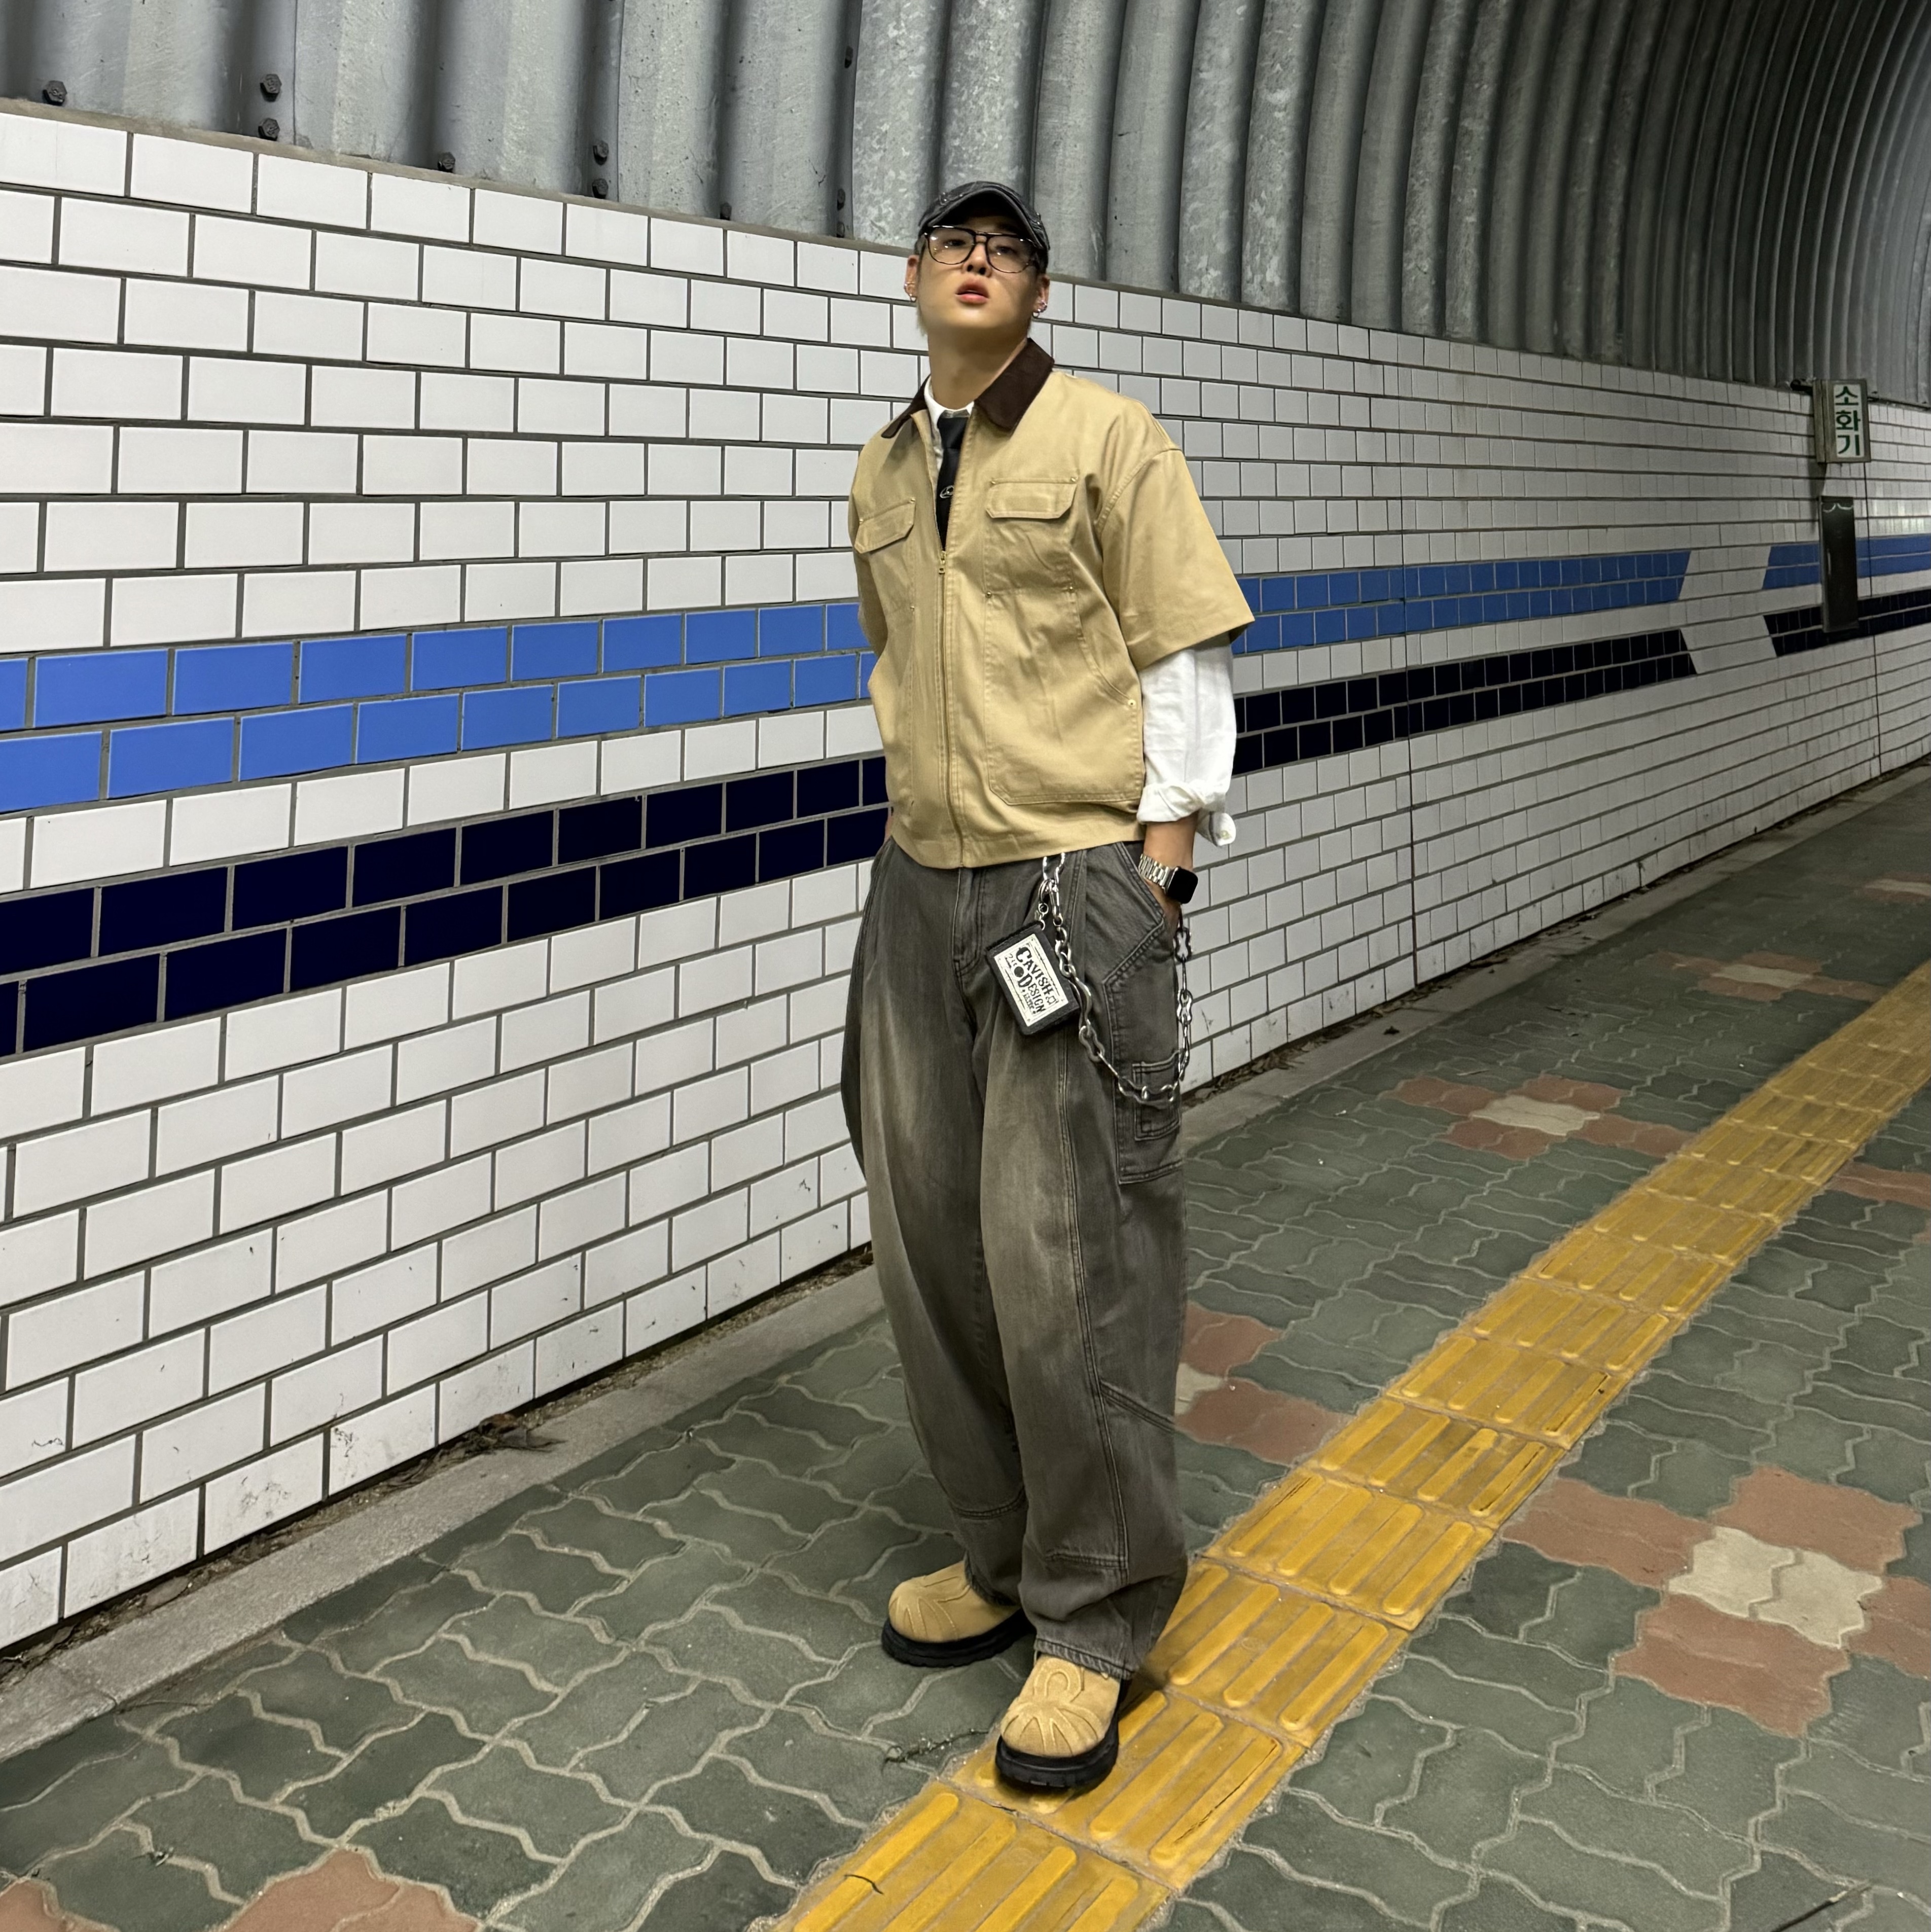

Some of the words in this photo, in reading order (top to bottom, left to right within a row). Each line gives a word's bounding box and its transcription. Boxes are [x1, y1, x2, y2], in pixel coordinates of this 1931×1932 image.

[1835, 386, 1861, 456] 소화기
[1016, 947, 1054, 995] CAVISH
[1018, 973, 1046, 1013] DESIGN
